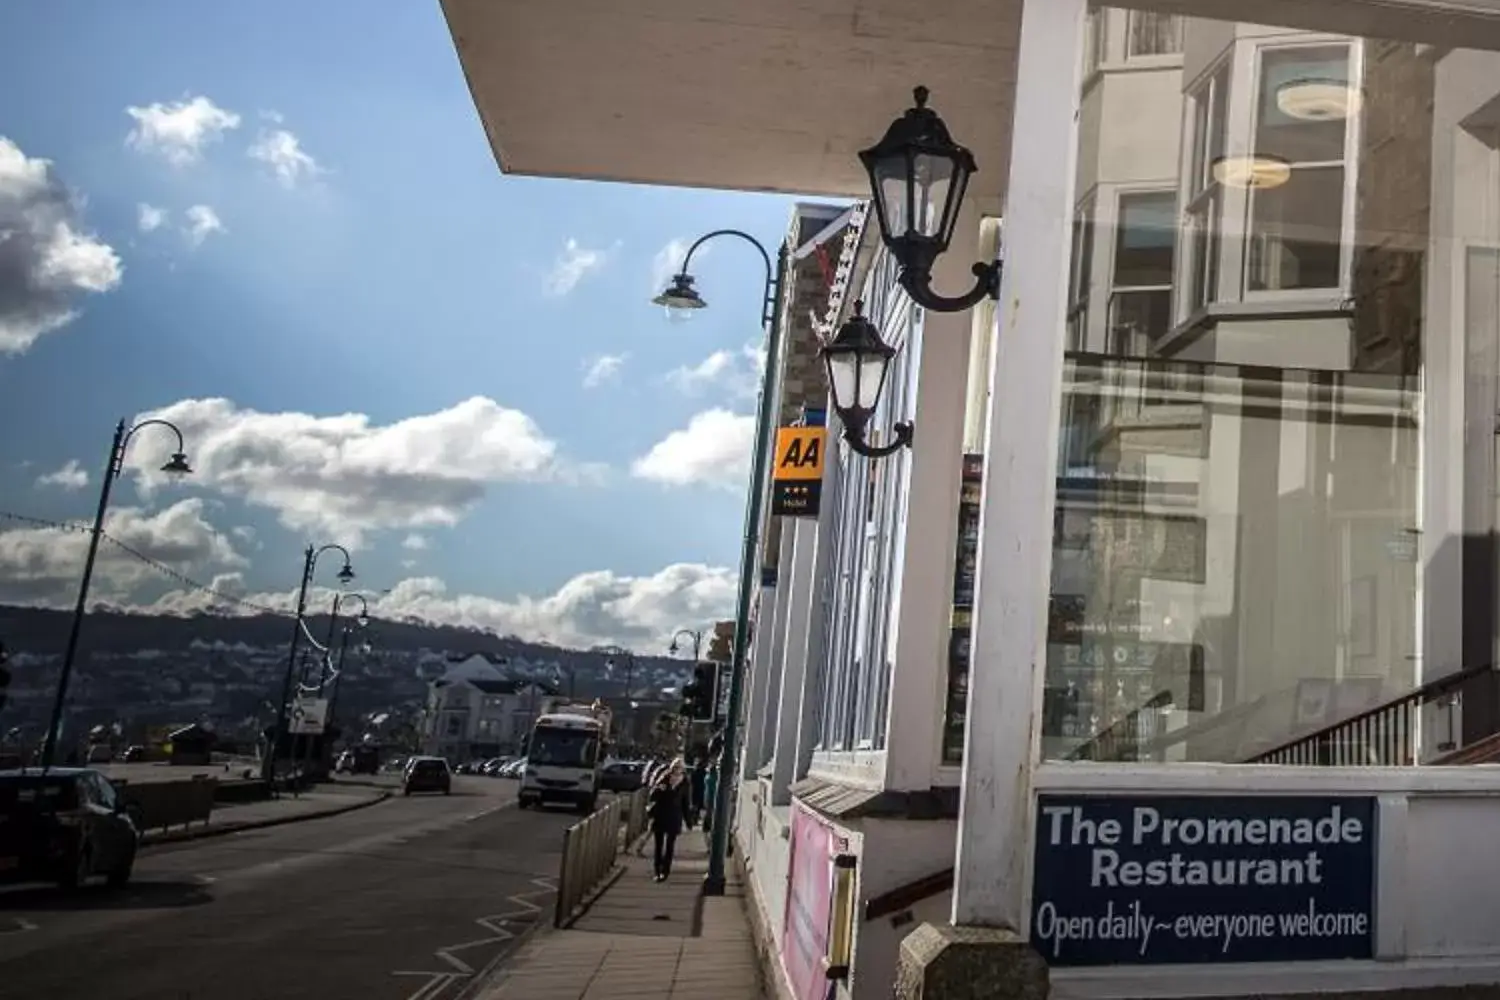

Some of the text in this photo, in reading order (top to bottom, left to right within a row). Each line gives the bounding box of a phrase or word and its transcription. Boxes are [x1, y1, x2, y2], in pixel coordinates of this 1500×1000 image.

[781, 437, 820, 468] AA
[1043, 806, 1363, 845] The Promenade
[1090, 849, 1323, 887] Restaurant
[1037, 902, 1094, 957] Open
[1279, 898, 1367, 937] welcome
